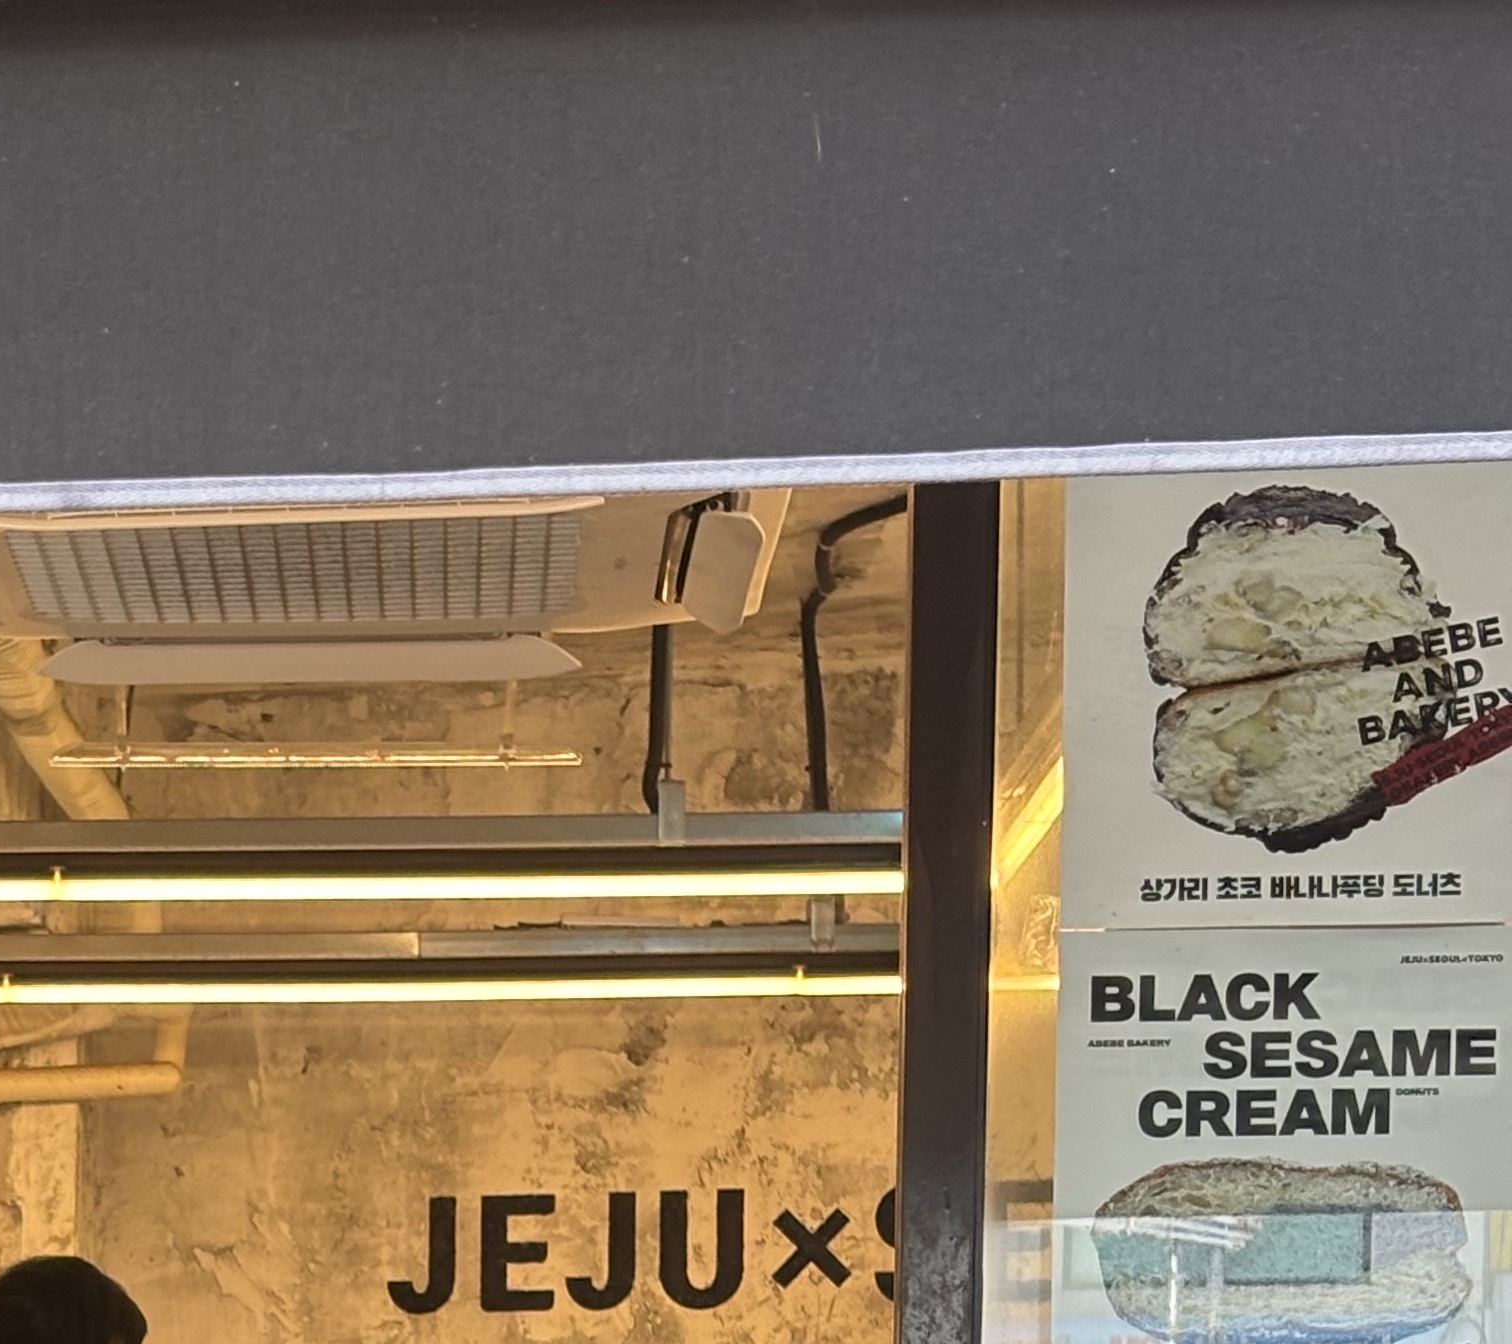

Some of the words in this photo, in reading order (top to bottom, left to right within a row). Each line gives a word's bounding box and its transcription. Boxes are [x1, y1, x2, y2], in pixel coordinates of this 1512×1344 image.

[1362, 616, 1503, 672] ABEBE
[1392, 658, 1483, 703] AND
[1140, 877, 1208, 902] 상가리
[1216, 877, 1262, 900] 초코
[1270, 875, 1385, 900] 바나나푸딩
[1392, 873, 1462, 898] 도너츠
[1090, 972, 1321, 1022] BLACK
[1203, 1028, 1497, 1080] SESAME
[1138, 1087, 1391, 1138] CREAM
